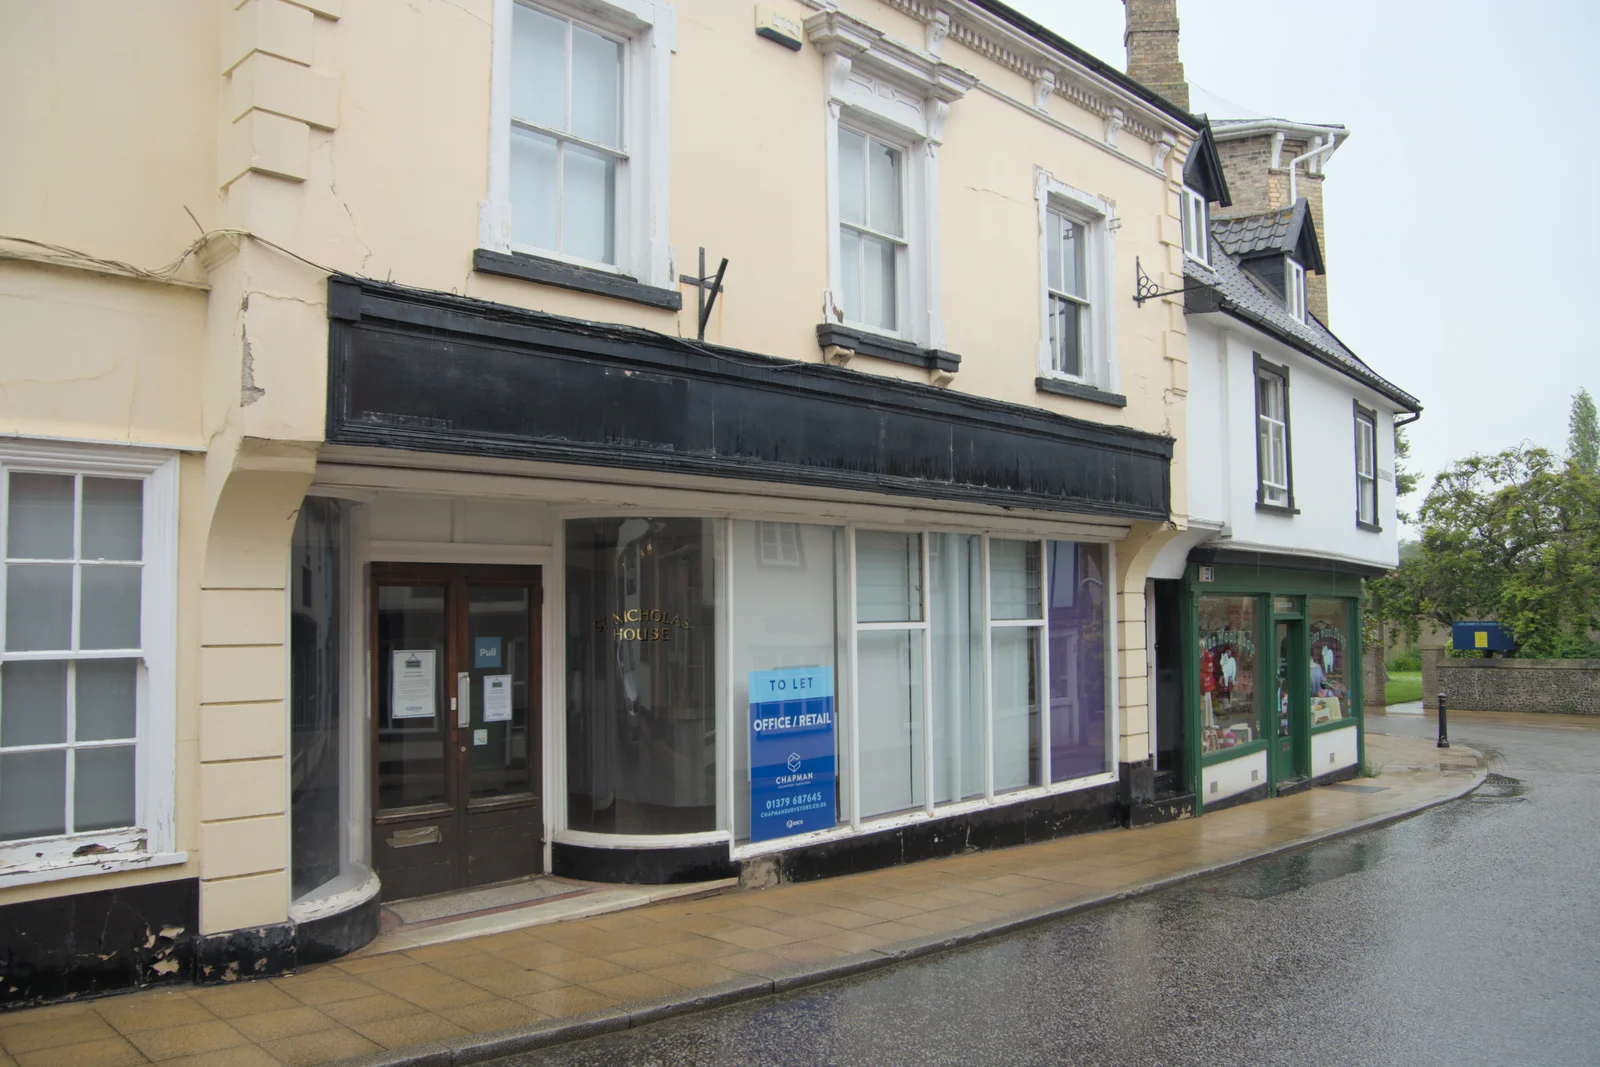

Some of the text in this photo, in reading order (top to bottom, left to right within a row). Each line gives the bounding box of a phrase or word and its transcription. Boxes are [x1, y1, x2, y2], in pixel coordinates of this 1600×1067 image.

[612, 608, 691, 631] NICHOLAS
[612, 628, 671, 641] HOUSE
[480, 647, 497, 657] Pull
[769, 677, 813, 692] TO LET
[753, 716, 791, 732] OFFICE
[799, 712, 832, 727] RETAIL
[775, 772, 813, 785] CHAPMAN
[766, 792, 822, 810] 01379 687645
